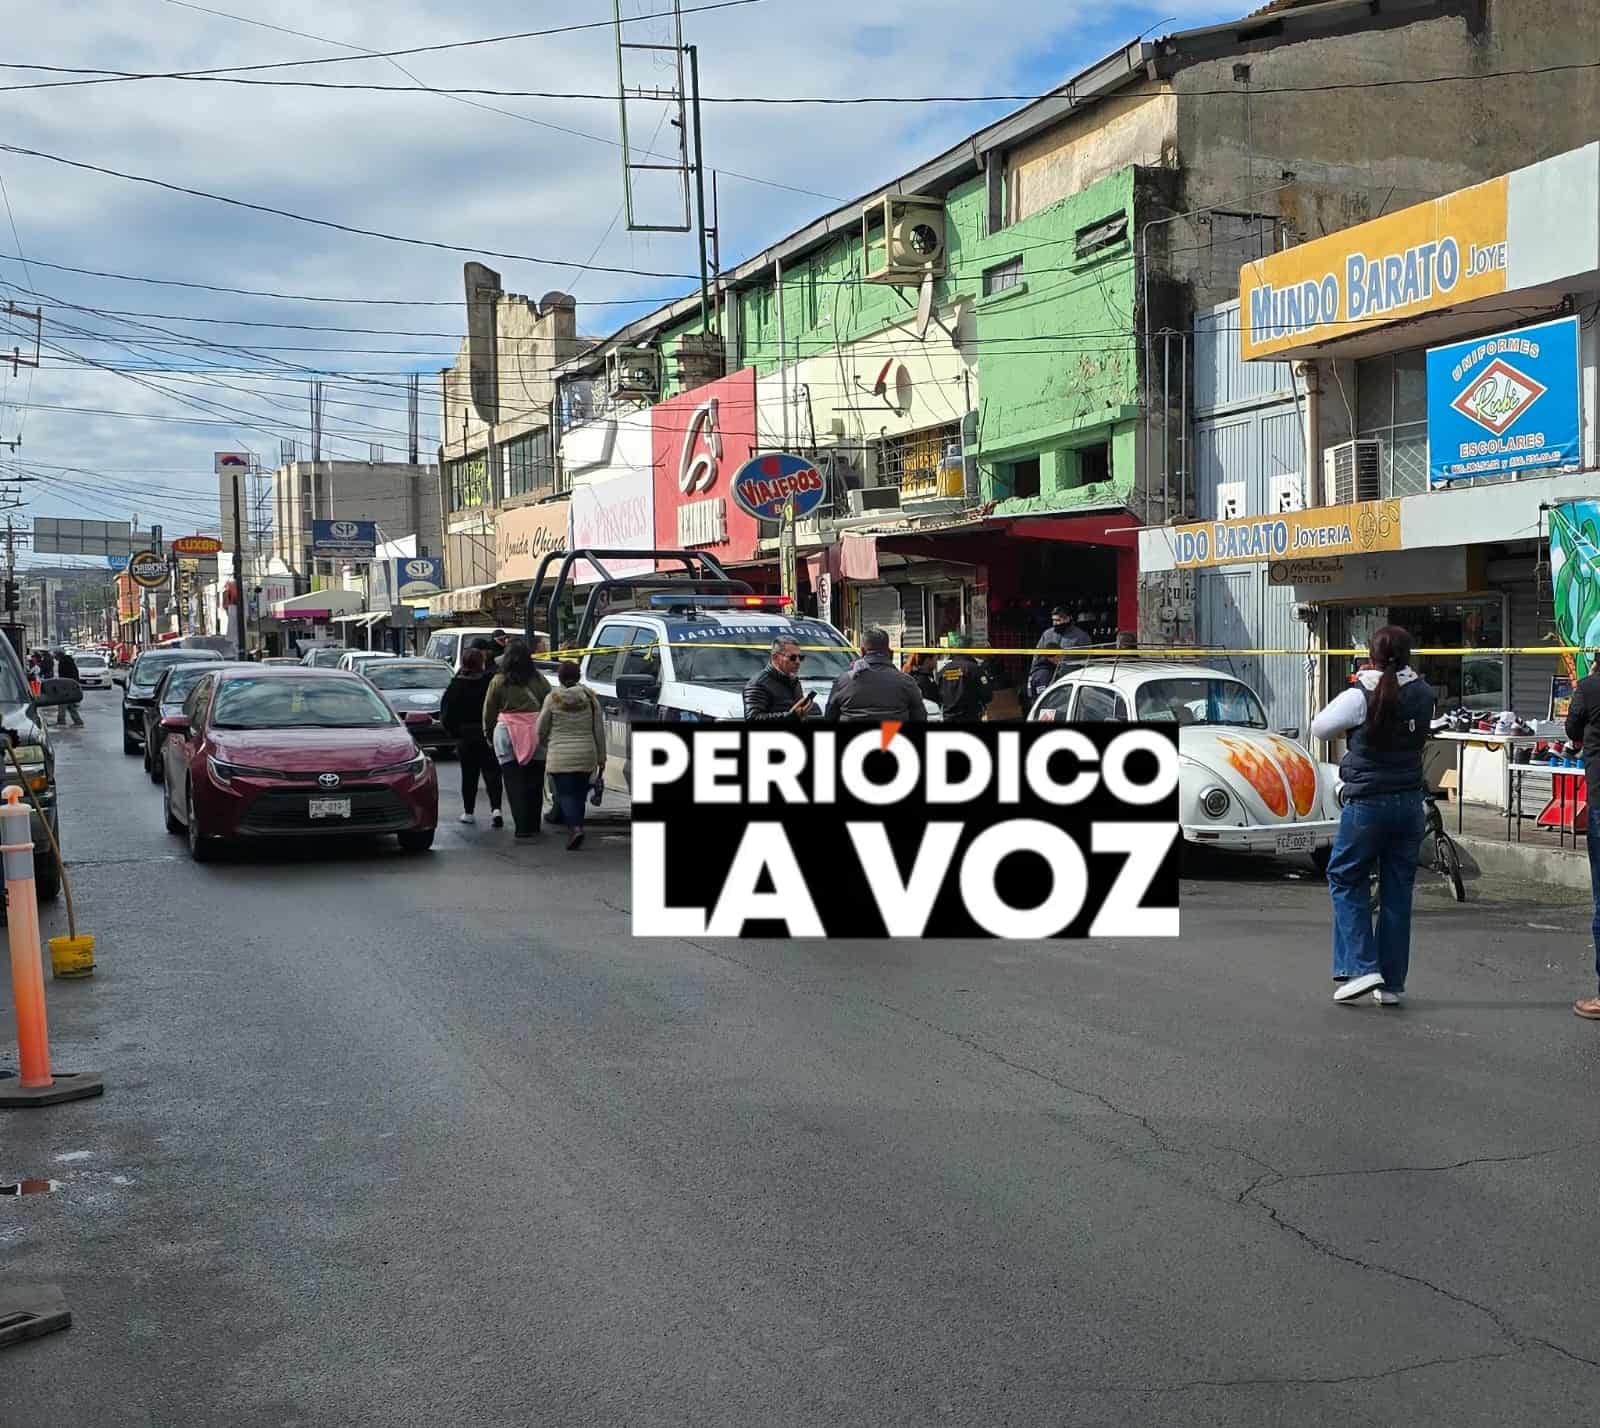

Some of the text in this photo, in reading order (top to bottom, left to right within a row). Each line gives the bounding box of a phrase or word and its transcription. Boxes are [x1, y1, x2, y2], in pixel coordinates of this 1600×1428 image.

[1250, 273, 1339, 346] MUNDO
[1345, 236, 1460, 320] BARATO
[1452, 338, 1540, 381] UNIFORMES
[1459, 432, 1545, 458] ESCOLARES
[1214, 520, 1288, 560] BARATO
[1292, 524, 1352, 549] JOYERIA
